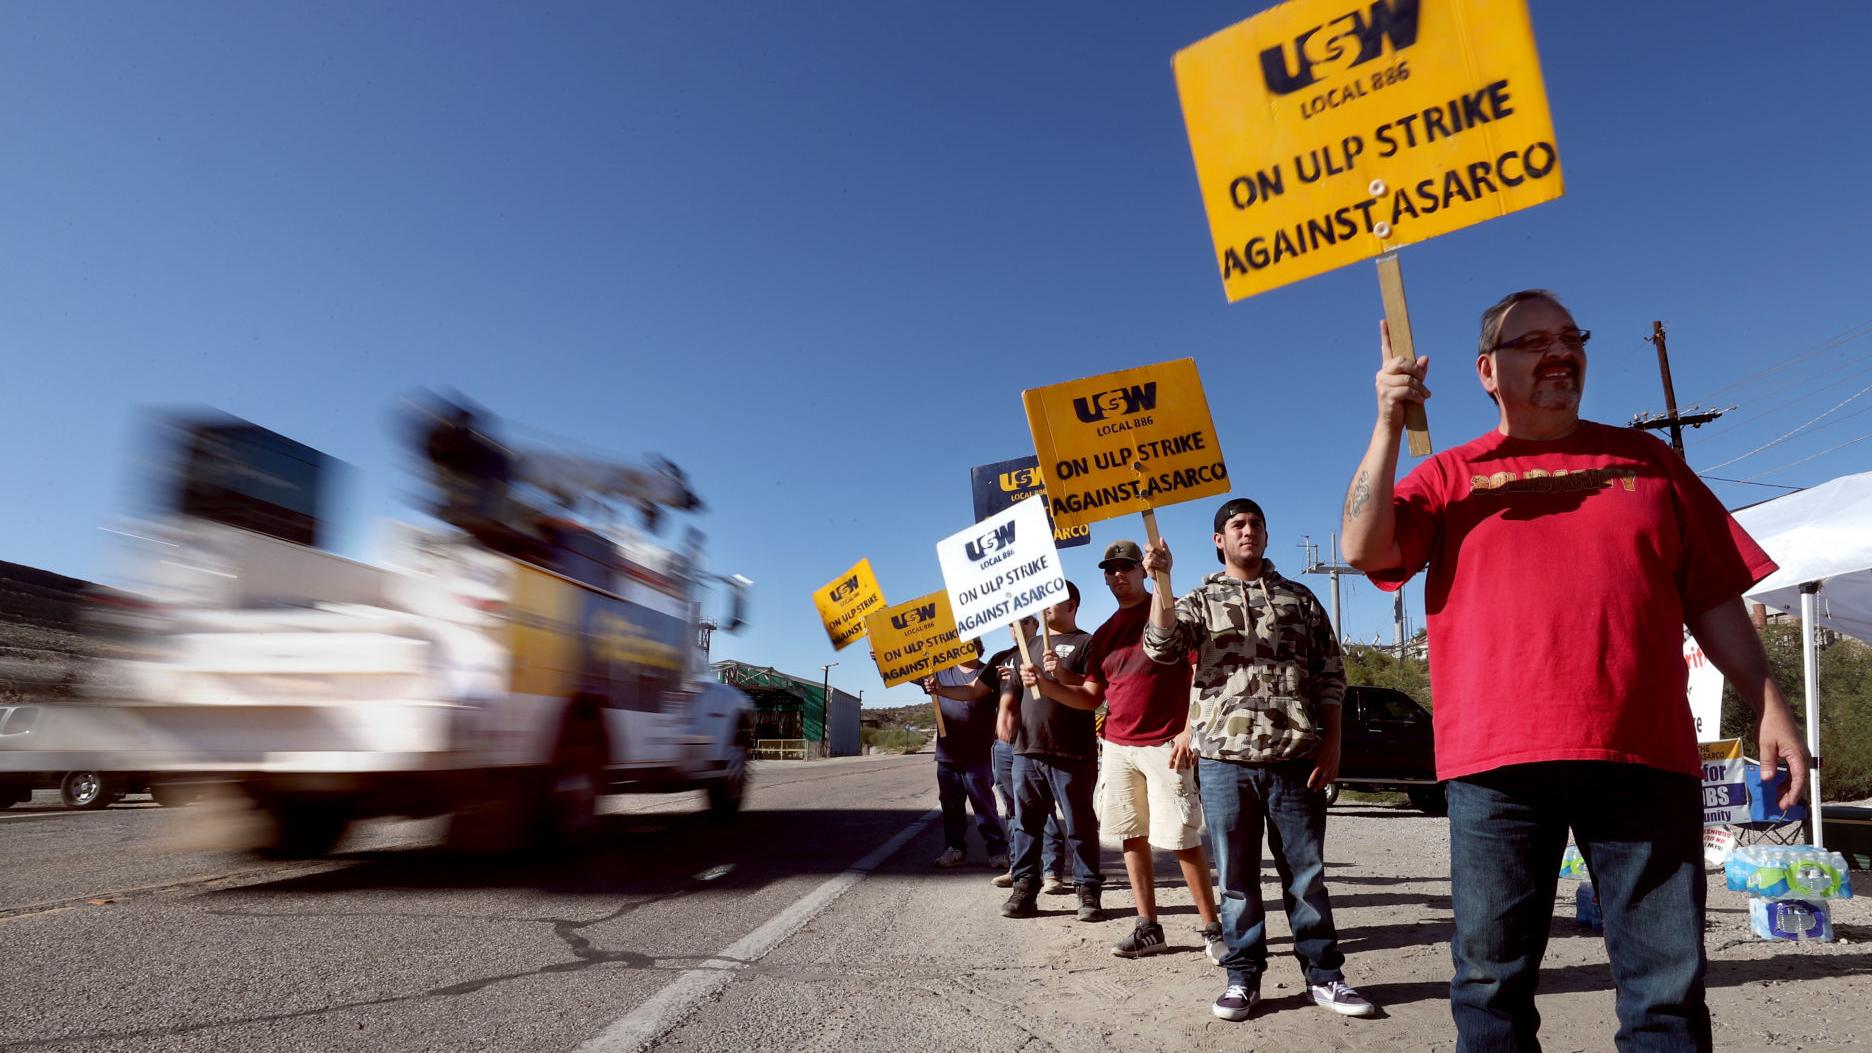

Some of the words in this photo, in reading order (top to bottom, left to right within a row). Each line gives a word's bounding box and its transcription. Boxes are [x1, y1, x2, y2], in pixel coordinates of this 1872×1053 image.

[1259, 0, 1421, 95] USW
[1301, 80, 1367, 119] LOCAL
[1371, 61, 1411, 91] 886
[1229, 163, 1285, 211] ON
[1295, 135, 1364, 185] ULP
[1375, 79, 1514, 158] STRIKE
[1223, 198, 1377, 280] AGAINST
[1391, 141, 1556, 225] ASARCO
[1073, 381, 1157, 423] USW
[1097, 420, 1133, 437] LOCAL
[1135, 415, 1154, 428] 886
[1056, 458, 1089, 481] ON
[1094, 447, 1133, 470] ULP
[1138, 431, 1206, 462] STRIKE
[1052, 480, 1141, 516] AGAINST
[1148, 462, 1227, 497] ASARCO
[965, 519, 1016, 562] USW
[1054, 523, 1089, 541] ARCO
[959, 587, 978, 605] ON
[980, 575, 1004, 596] ULP
[1006, 555, 1048, 585] STRIKE
[980, 555, 1002, 570] LOCAL
[829, 618, 842, 630] ON
[842, 608, 856, 622] ULP
[857, 592, 879, 614] STRIKE
[891, 602, 935, 630] USW
[958, 600, 1010, 634] AGAINST
[1014, 577, 1064, 611] ASARCO
[834, 621, 863, 644] AINST
[884, 648, 902, 662] ON
[904, 640, 924, 655] ULP
[904, 626, 923, 637] LOCAL
[883, 657, 930, 682] AGAINST
[933, 642, 975, 666] ASARCO
[1703, 786, 1730, 807] BS
[1704, 809, 1732, 823] unity
[1704, 829, 1732, 839] AGAINS
